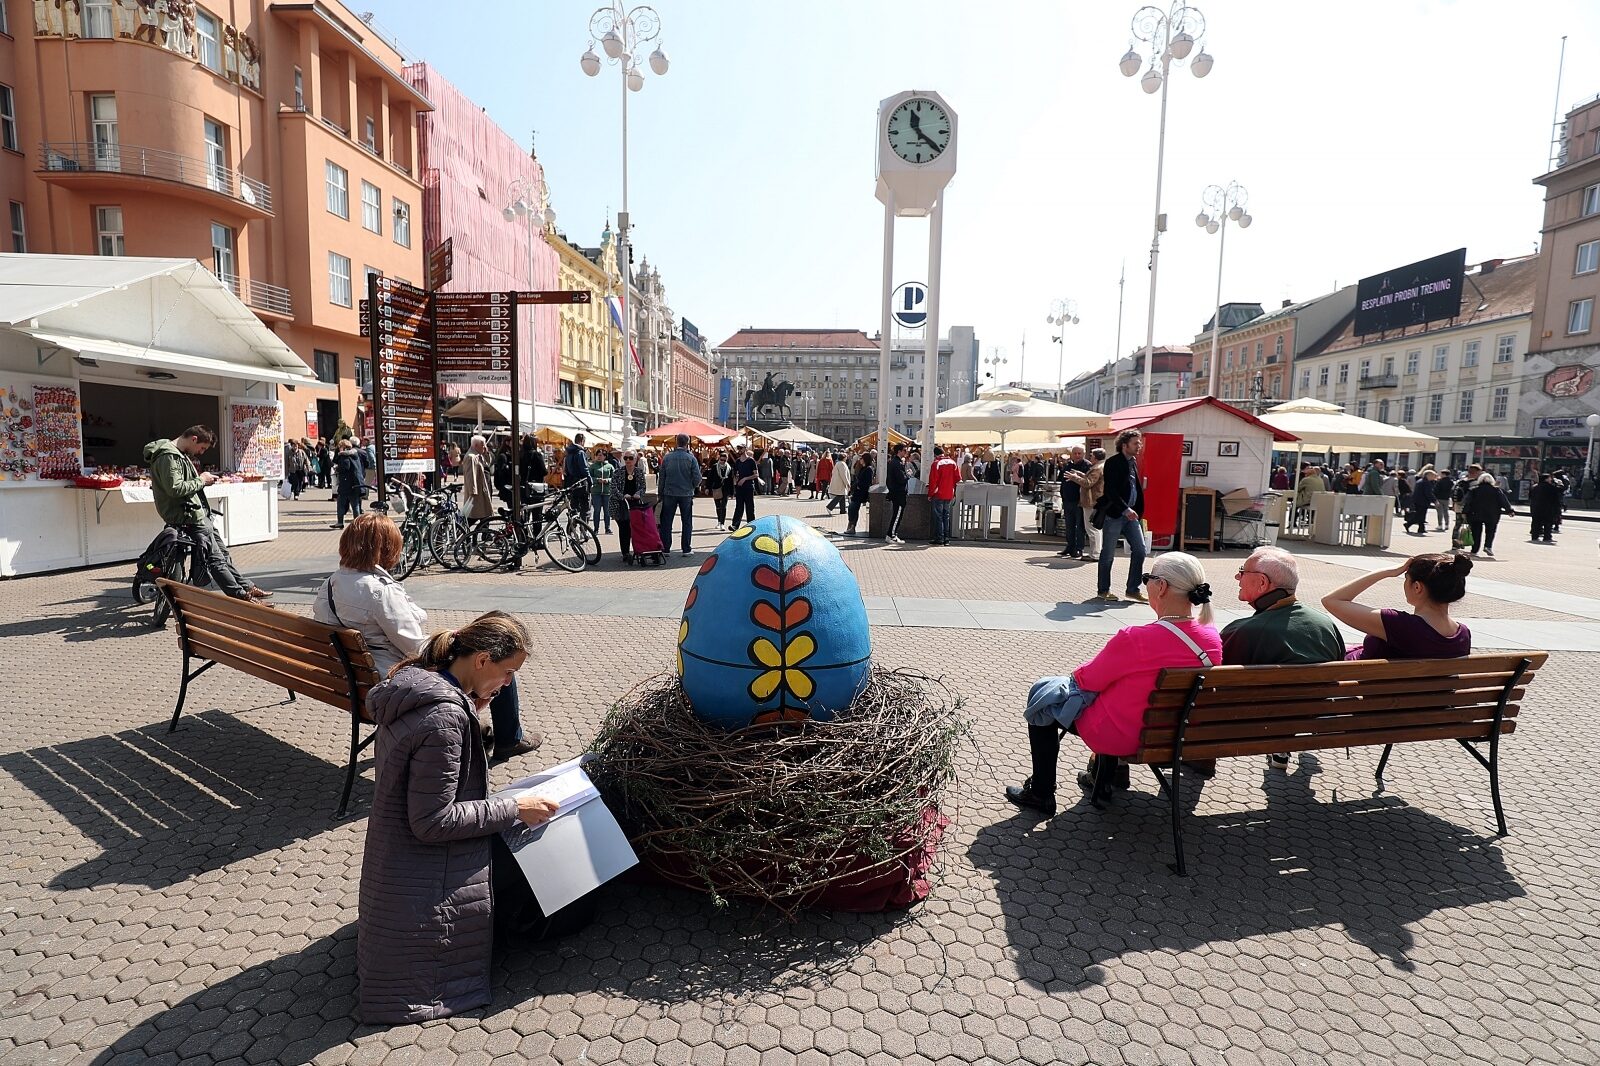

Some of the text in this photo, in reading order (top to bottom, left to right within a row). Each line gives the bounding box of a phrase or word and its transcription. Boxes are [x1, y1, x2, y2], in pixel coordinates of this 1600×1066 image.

[1361, 278, 1451, 311] BESPLATNI PROBNI TRENING
[1540, 418, 1584, 428] ADMIRAL
